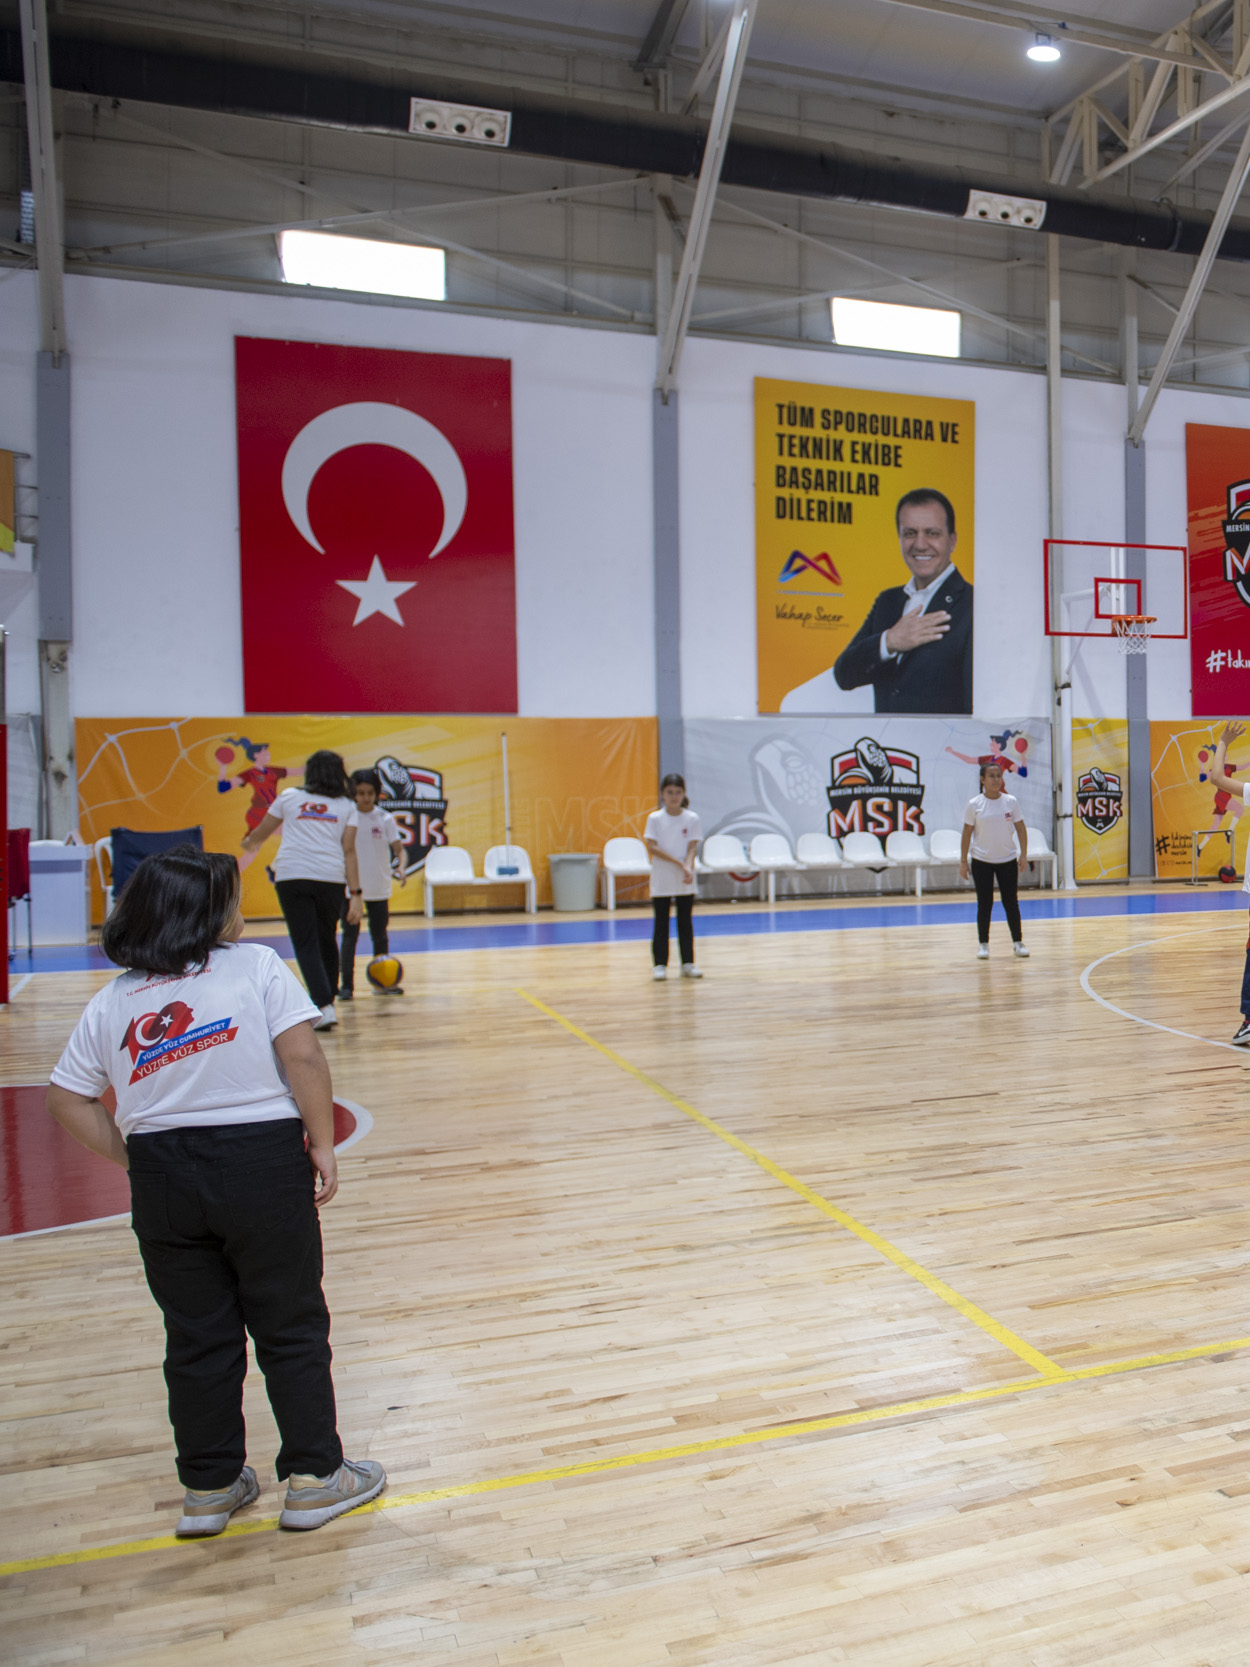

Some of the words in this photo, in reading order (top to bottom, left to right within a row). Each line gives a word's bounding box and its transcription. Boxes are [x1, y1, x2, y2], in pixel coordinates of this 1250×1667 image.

[775, 401, 815, 428] TÜM
[821, 408, 935, 441] SPORCULARA
[939, 421, 960, 444] VE
[775, 433, 844, 462] TEKNİK
[850, 439, 903, 468] EKİBE
[775, 465, 880, 496] BAŞARILAR
[775, 493, 853, 525] DİLERİM
[1225, 522, 1250, 533] MERSİN
[829, 797, 923, 837] MSK
[1077, 797, 1121, 817] MSK
[392, 810, 446, 846] SK
[142, 1048, 163, 1061] YÜZDE
[164, 1041, 179, 1052] YÜZ
[179, 1022, 226, 1044] CUMHURİYET
[171, 1045, 195, 1060] YÜZ
[196, 1033, 229, 1051] SPOR
